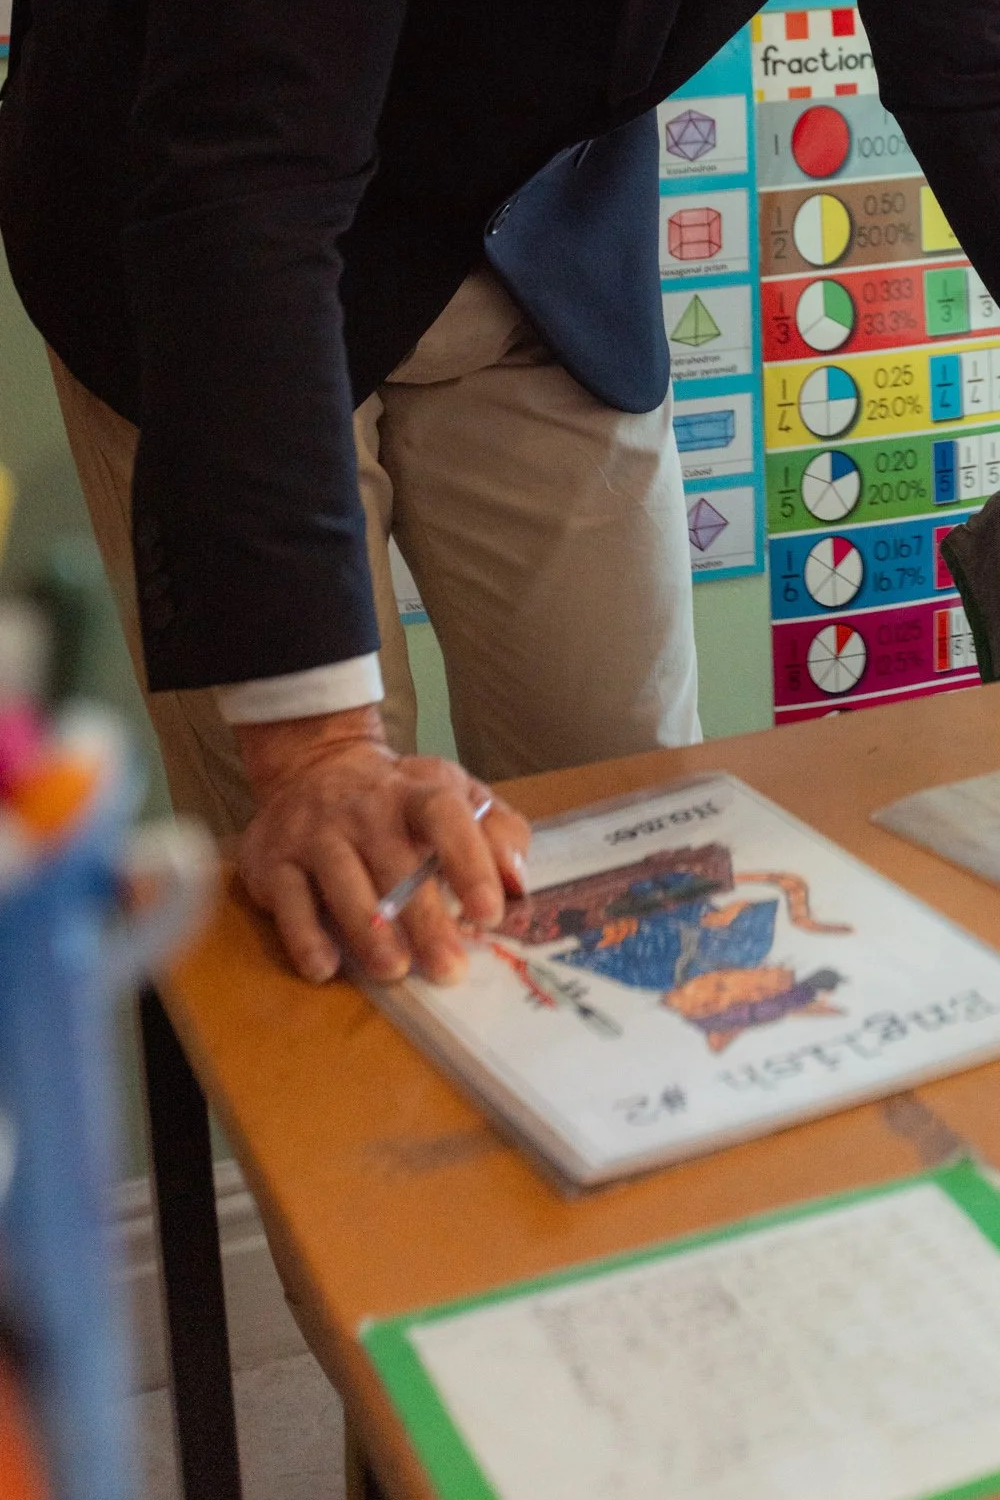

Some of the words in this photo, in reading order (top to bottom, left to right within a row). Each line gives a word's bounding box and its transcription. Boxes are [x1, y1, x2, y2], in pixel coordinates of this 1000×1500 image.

[867, 394, 923, 420] 25.0%
[869, 479, 927, 505] 20.0%
[716, 988, 999, 1092] English
